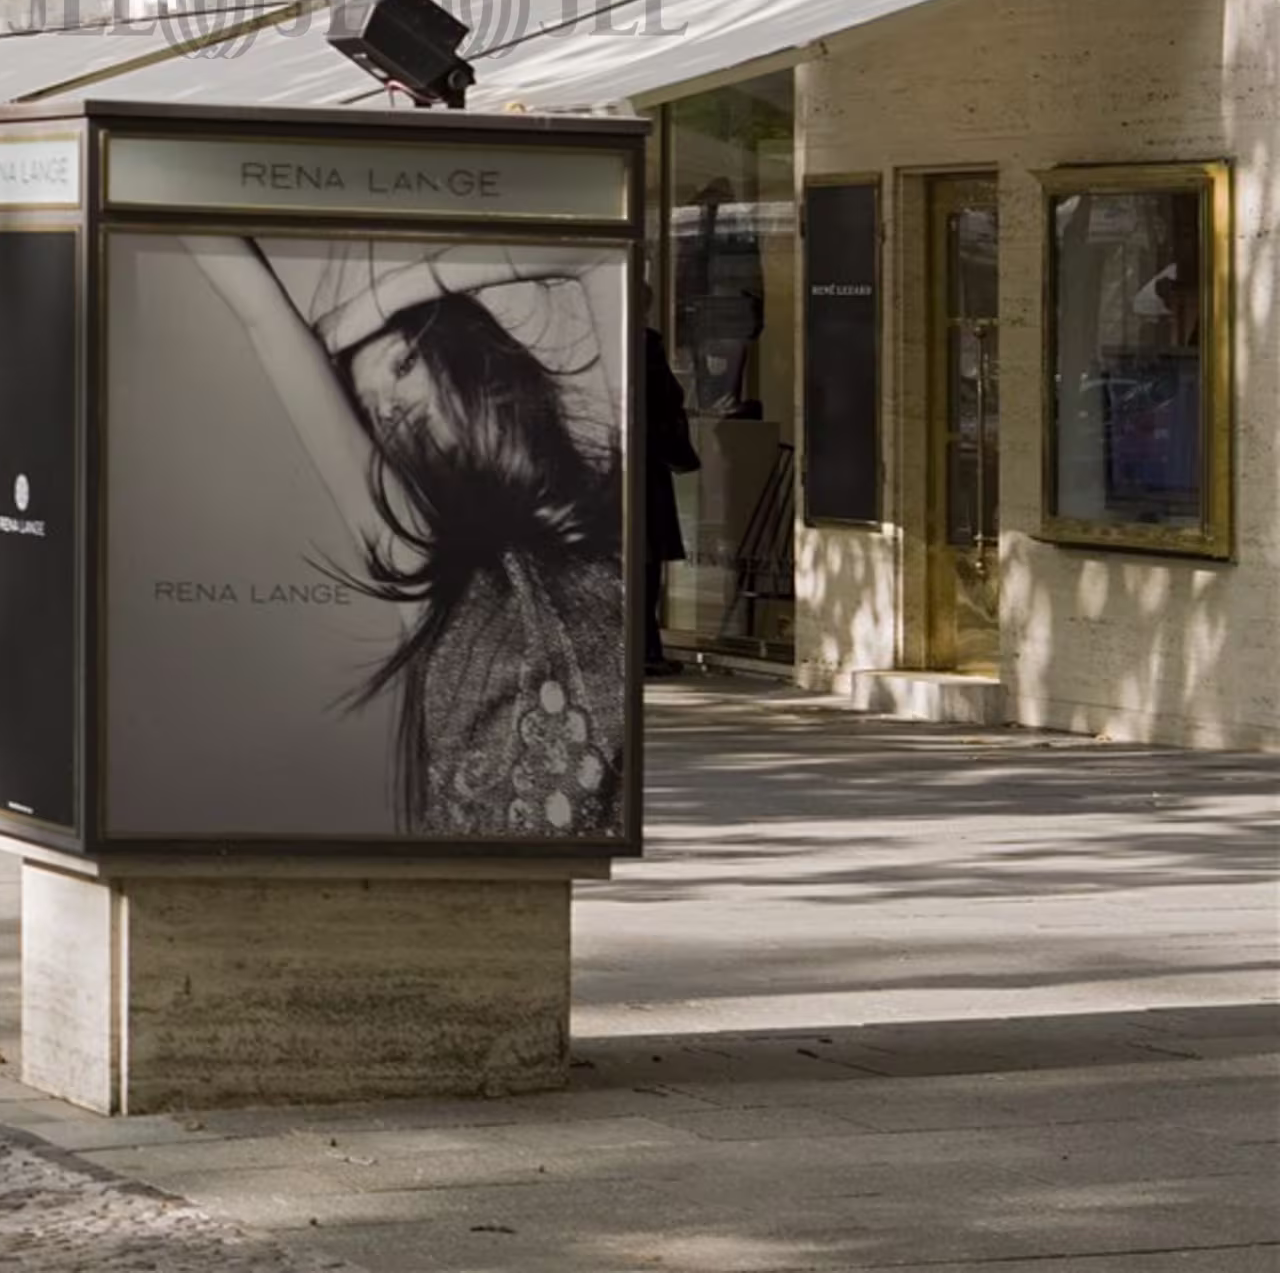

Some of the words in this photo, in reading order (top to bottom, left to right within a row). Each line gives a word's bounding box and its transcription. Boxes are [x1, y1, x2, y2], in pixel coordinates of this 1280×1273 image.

[241, 162, 346, 191] RENA
[368, 168, 502, 198] LANGE
[153, 581, 239, 603] RENA
[249, 582, 352, 606] LANGE
